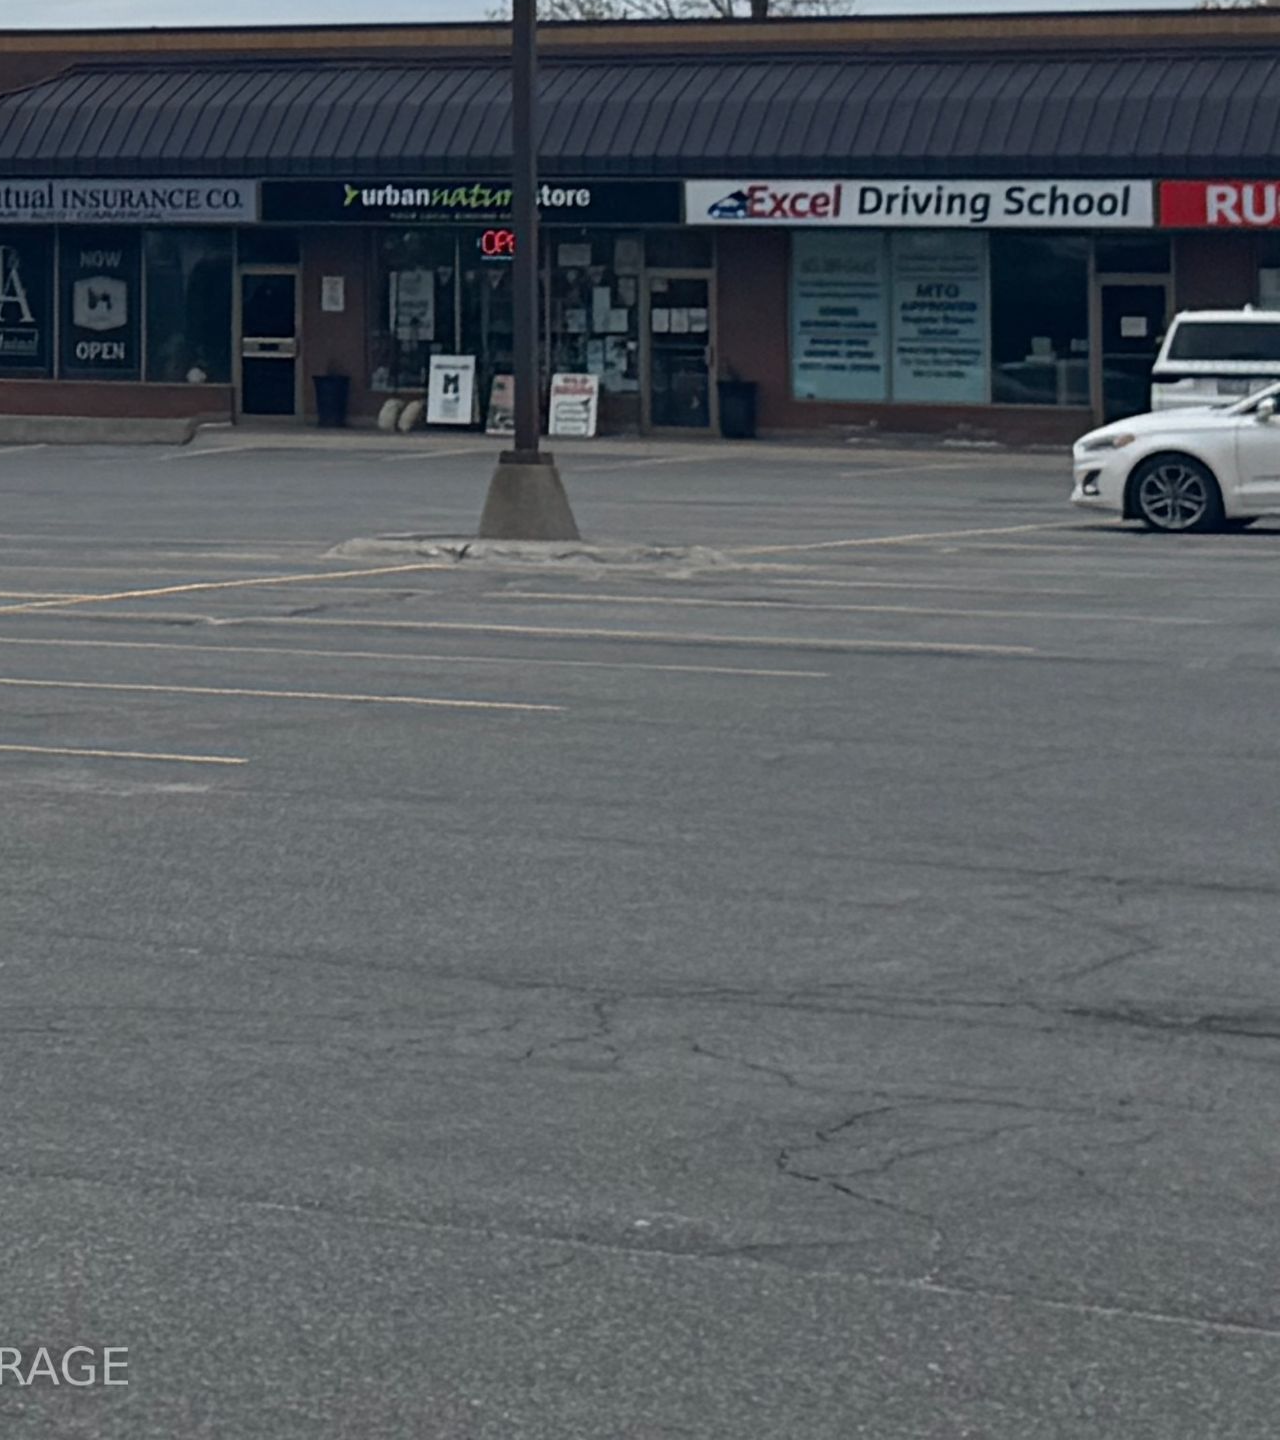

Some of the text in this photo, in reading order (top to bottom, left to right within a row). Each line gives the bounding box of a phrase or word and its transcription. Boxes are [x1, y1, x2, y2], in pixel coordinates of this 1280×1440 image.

[62, 187, 201, 209] INSURANCE
[745, 183, 1131, 223] Excel Driving School
[1205, 183, 1280, 225] RU
[75, 341, 126, 360] OPEN
